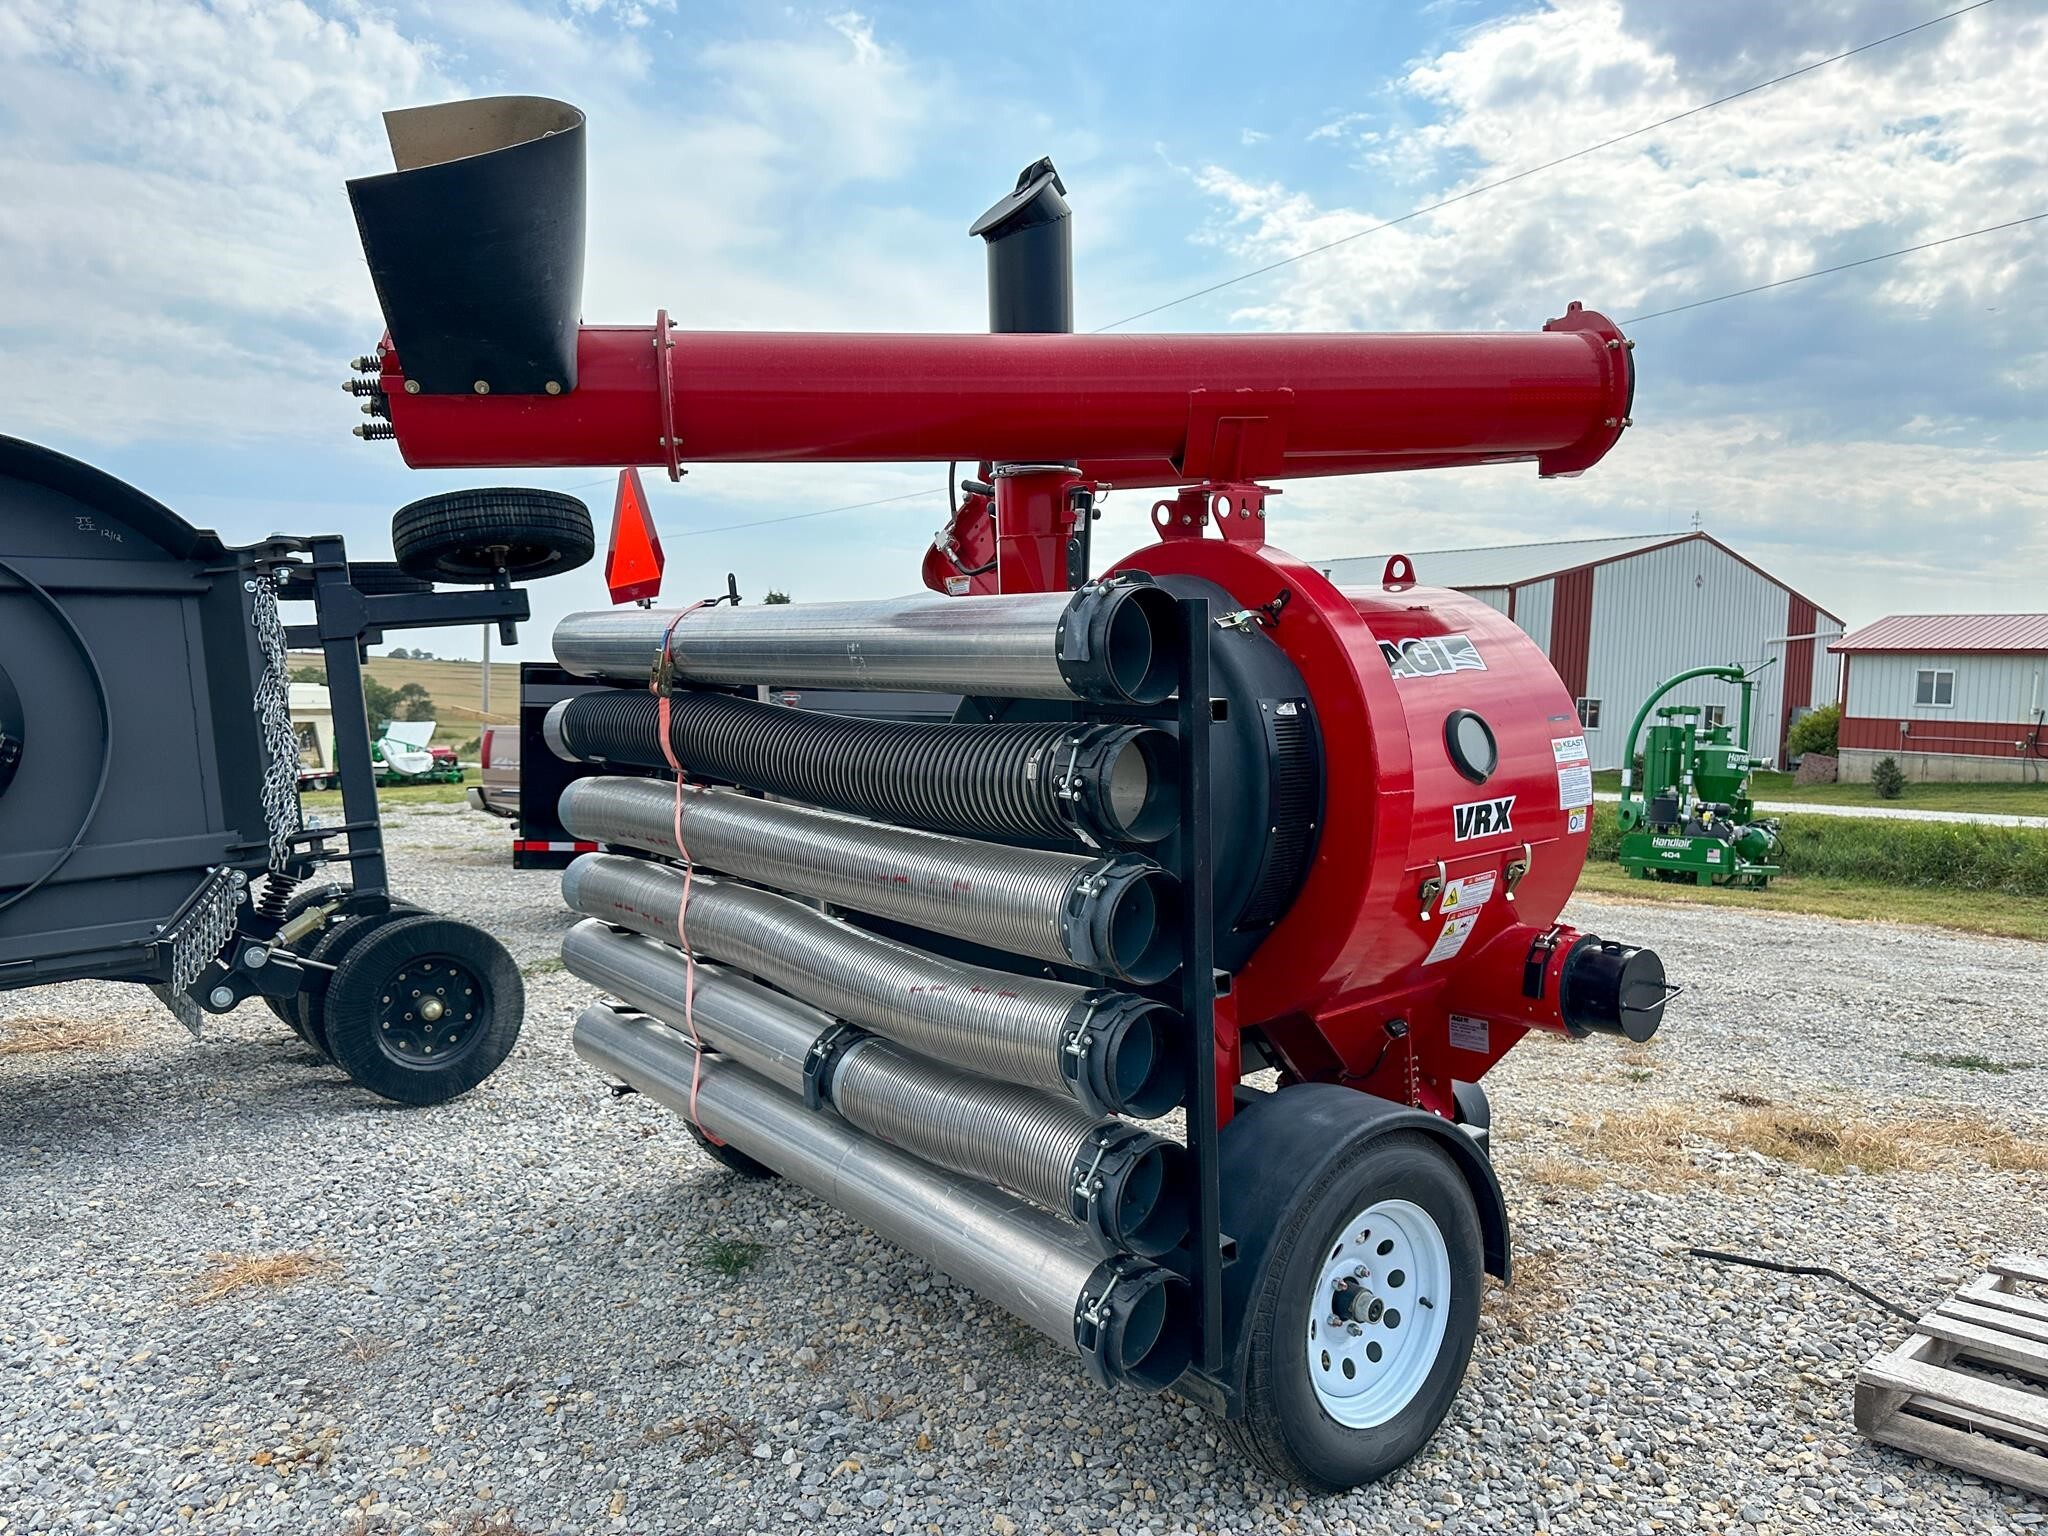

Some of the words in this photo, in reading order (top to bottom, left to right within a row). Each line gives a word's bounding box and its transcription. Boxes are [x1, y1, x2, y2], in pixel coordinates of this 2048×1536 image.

[1378, 638, 1455, 676] AGI
[1562, 738, 1584, 748] KEAST
[1455, 799, 1514, 839] VRX
[1660, 851, 1681, 859] 404
